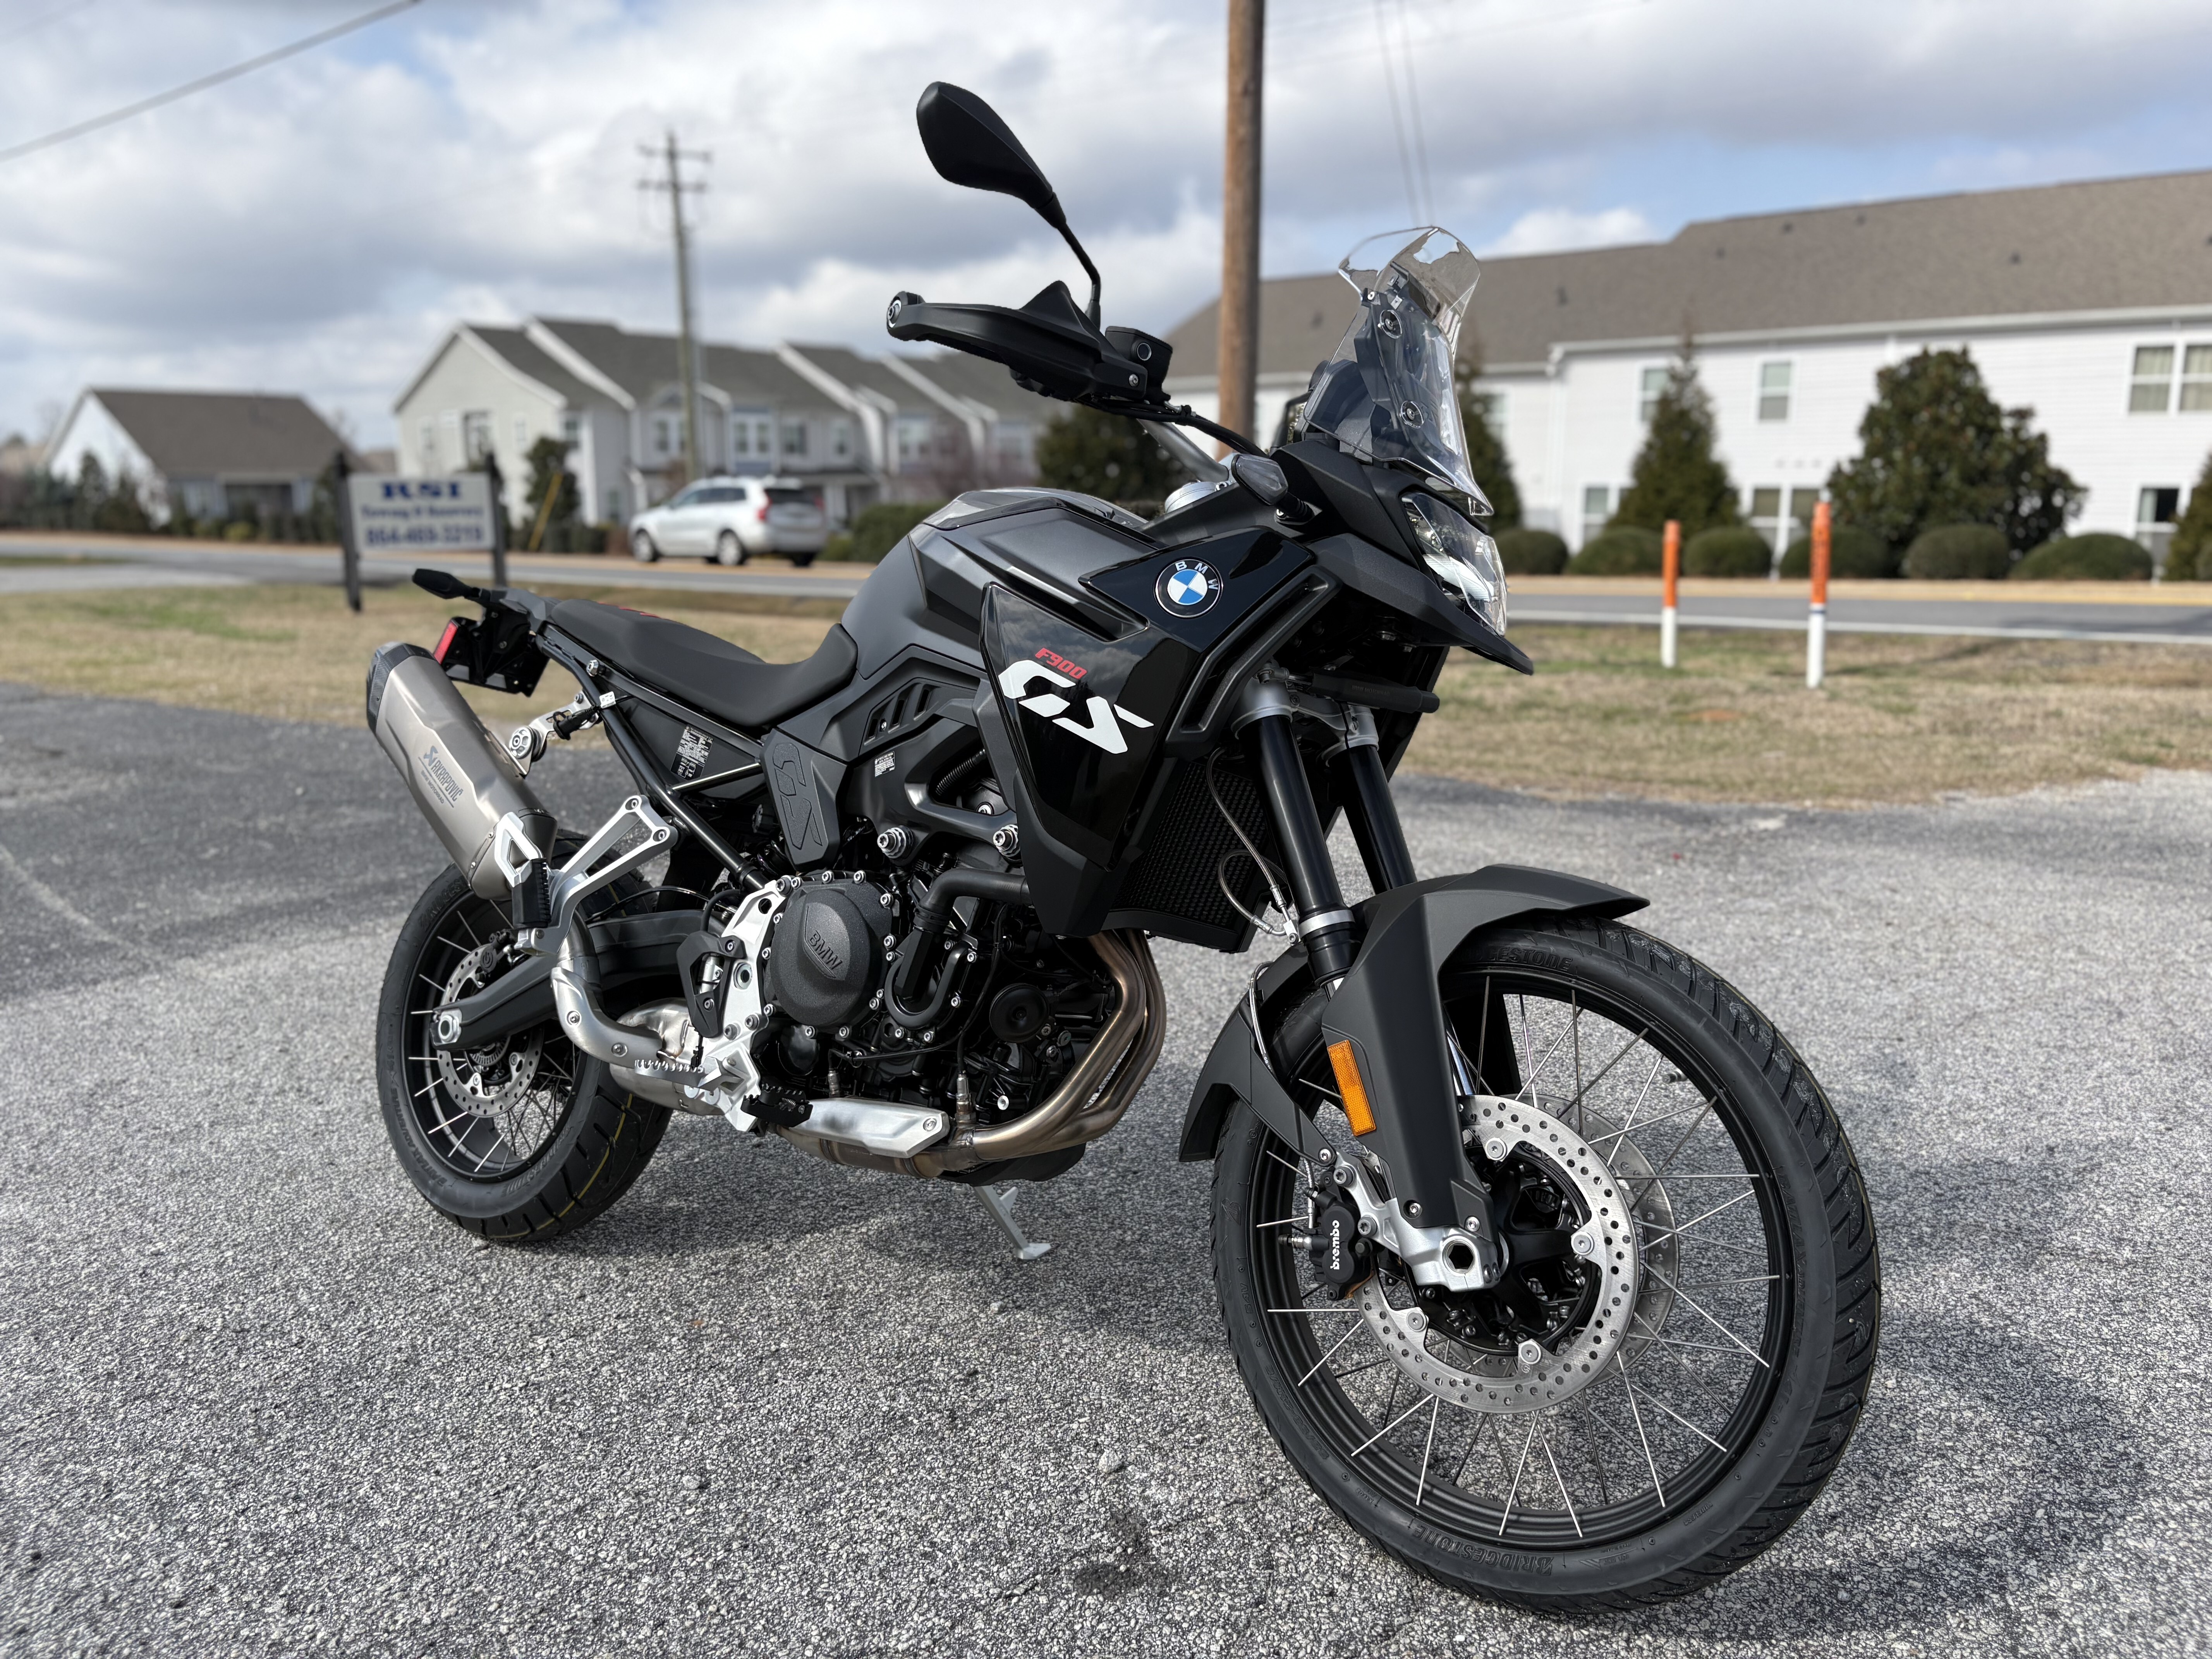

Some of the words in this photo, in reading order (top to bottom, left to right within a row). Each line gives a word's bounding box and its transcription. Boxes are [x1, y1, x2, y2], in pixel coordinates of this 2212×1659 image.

[1175, 561, 1219, 590] BMW
[1035, 647, 1087, 679] F900
[428, 780, 445, 804] MOTORRAD
[431, 760, 464, 802] AKRAPOVIČ
[809, 929, 843, 970] BMW
[1330, 1220, 1340, 1270] brembo
[1413, 1523, 1554, 1576] BRIDGESTONE
